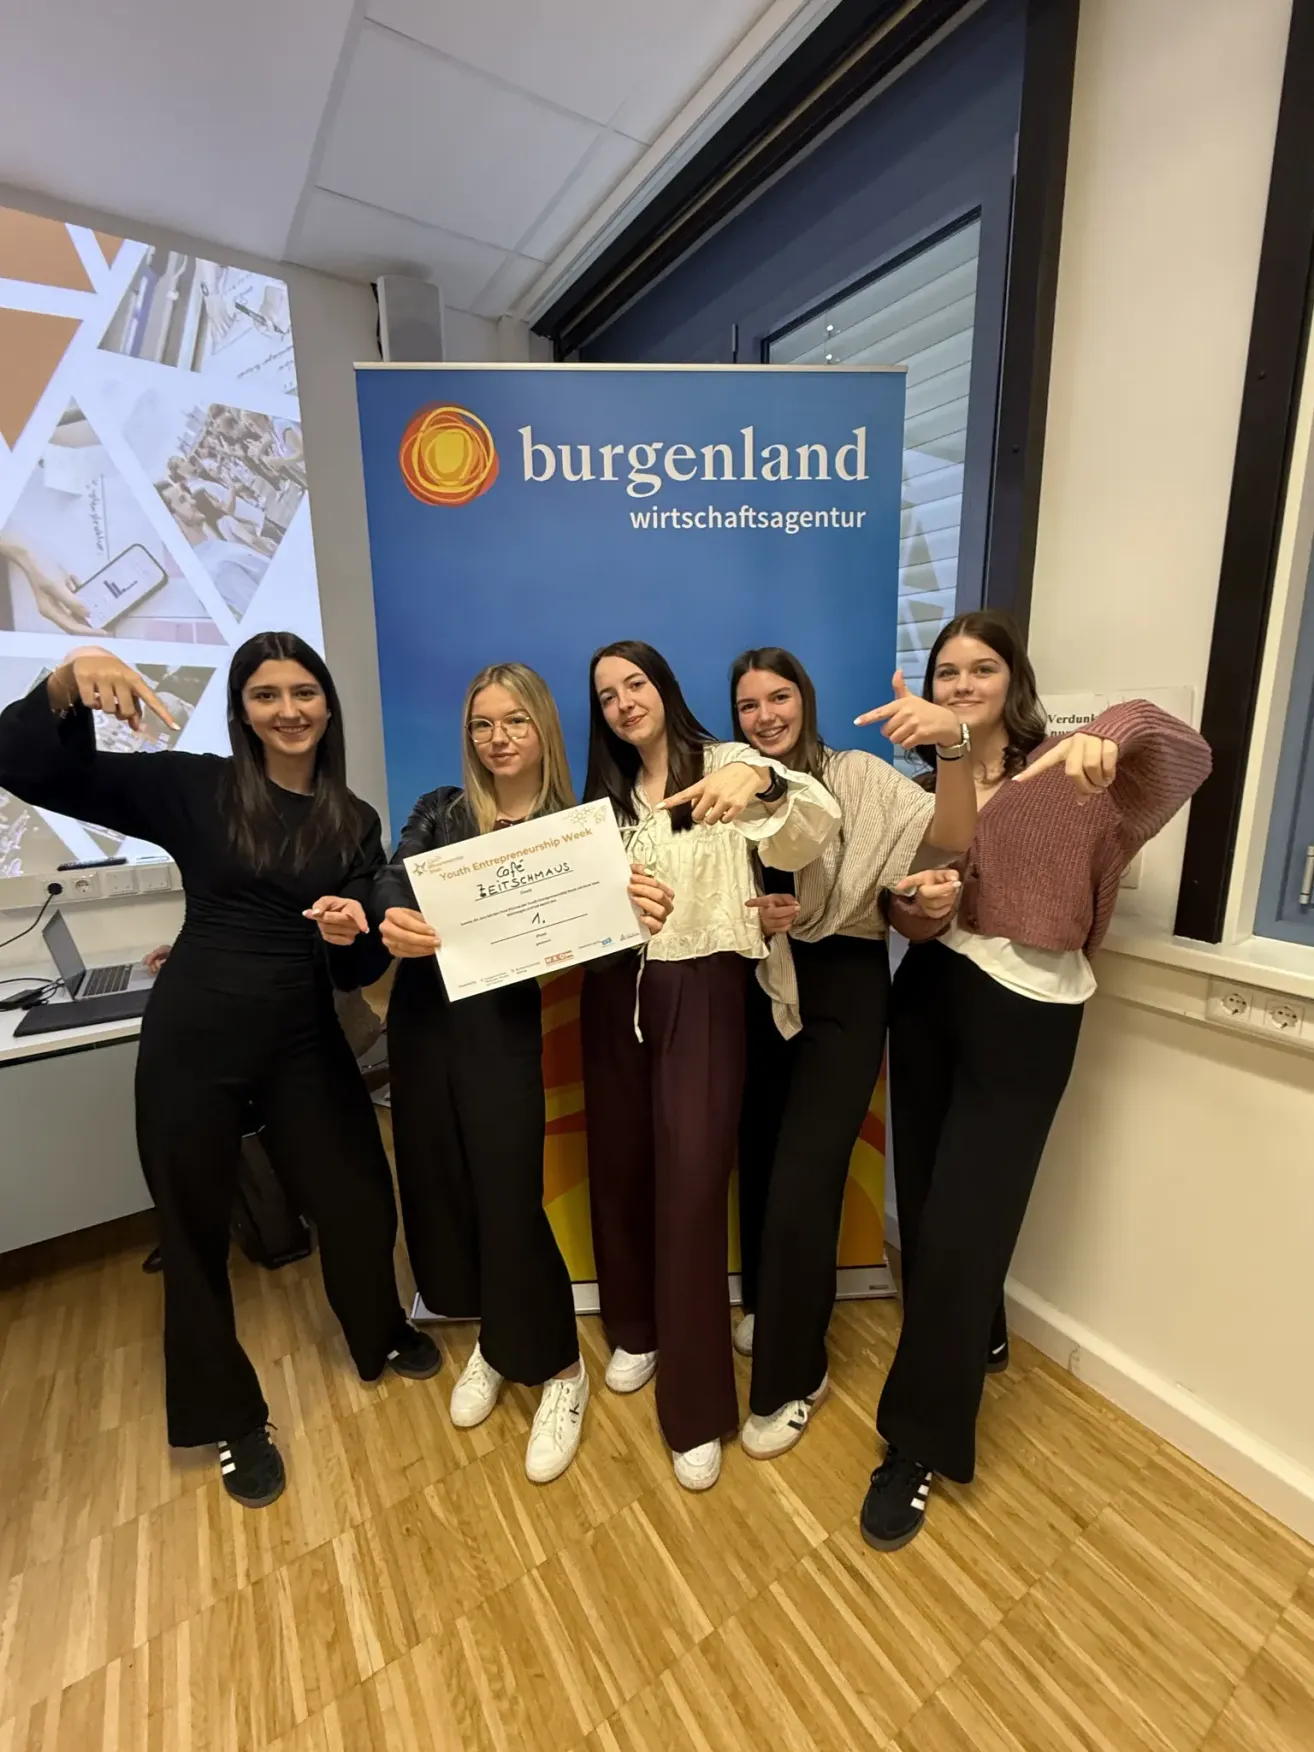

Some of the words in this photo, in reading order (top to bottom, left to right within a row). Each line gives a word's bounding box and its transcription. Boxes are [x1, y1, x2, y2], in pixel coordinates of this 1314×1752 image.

[518, 425, 869, 498] burgenland
[630, 505, 867, 534] wirtschaftsagentur
[440, 865, 471, 881] Youth
[472, 839, 561, 871] Entrepreneurship
[561, 827, 593, 844] Week
[496, 859, 525, 878] Café
